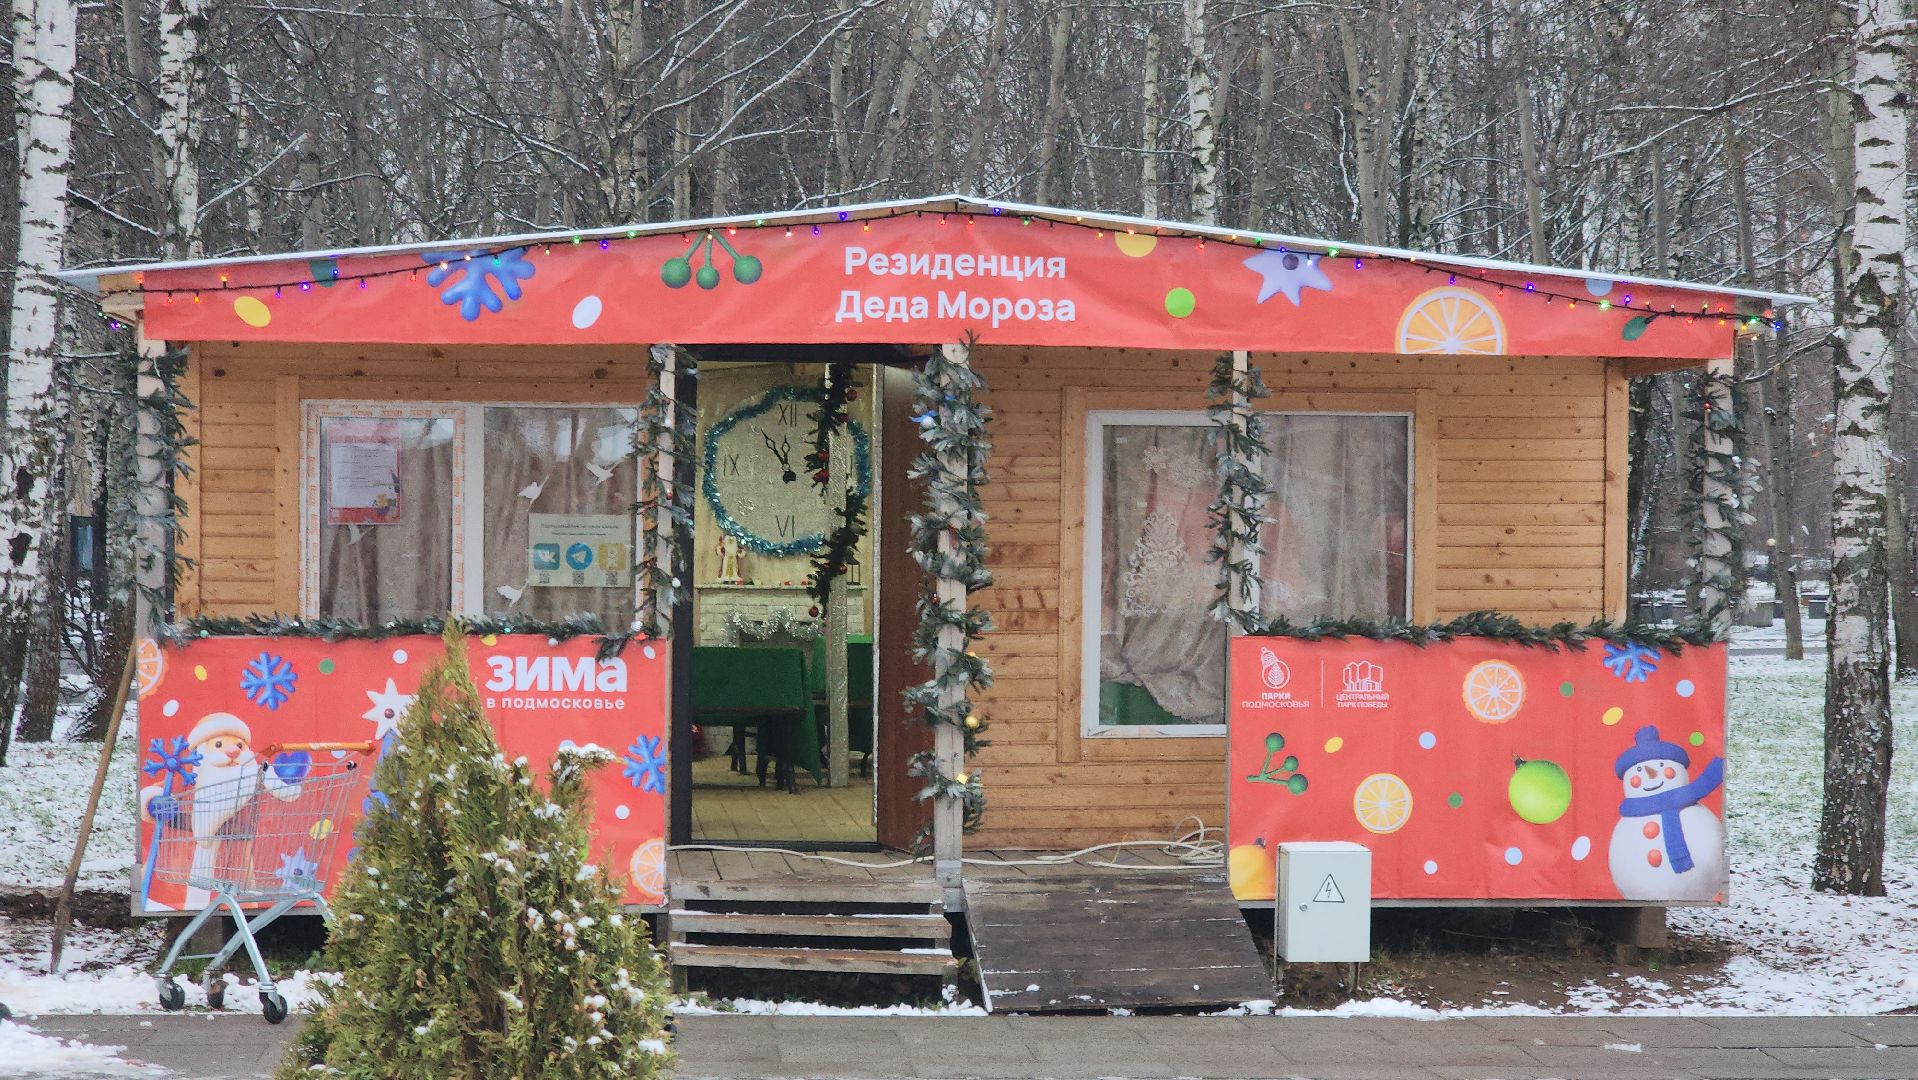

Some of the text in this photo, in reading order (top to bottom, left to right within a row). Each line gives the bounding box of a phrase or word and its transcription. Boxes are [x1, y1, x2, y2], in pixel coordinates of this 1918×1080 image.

[844, 246, 1066, 281] Резиденция
[835, 290, 1076, 328] Деда Мороза
[486, 697, 625, 710] в подмосковье
[1241, 700, 1310, 708] ПОДМОСКОВЬЯ
